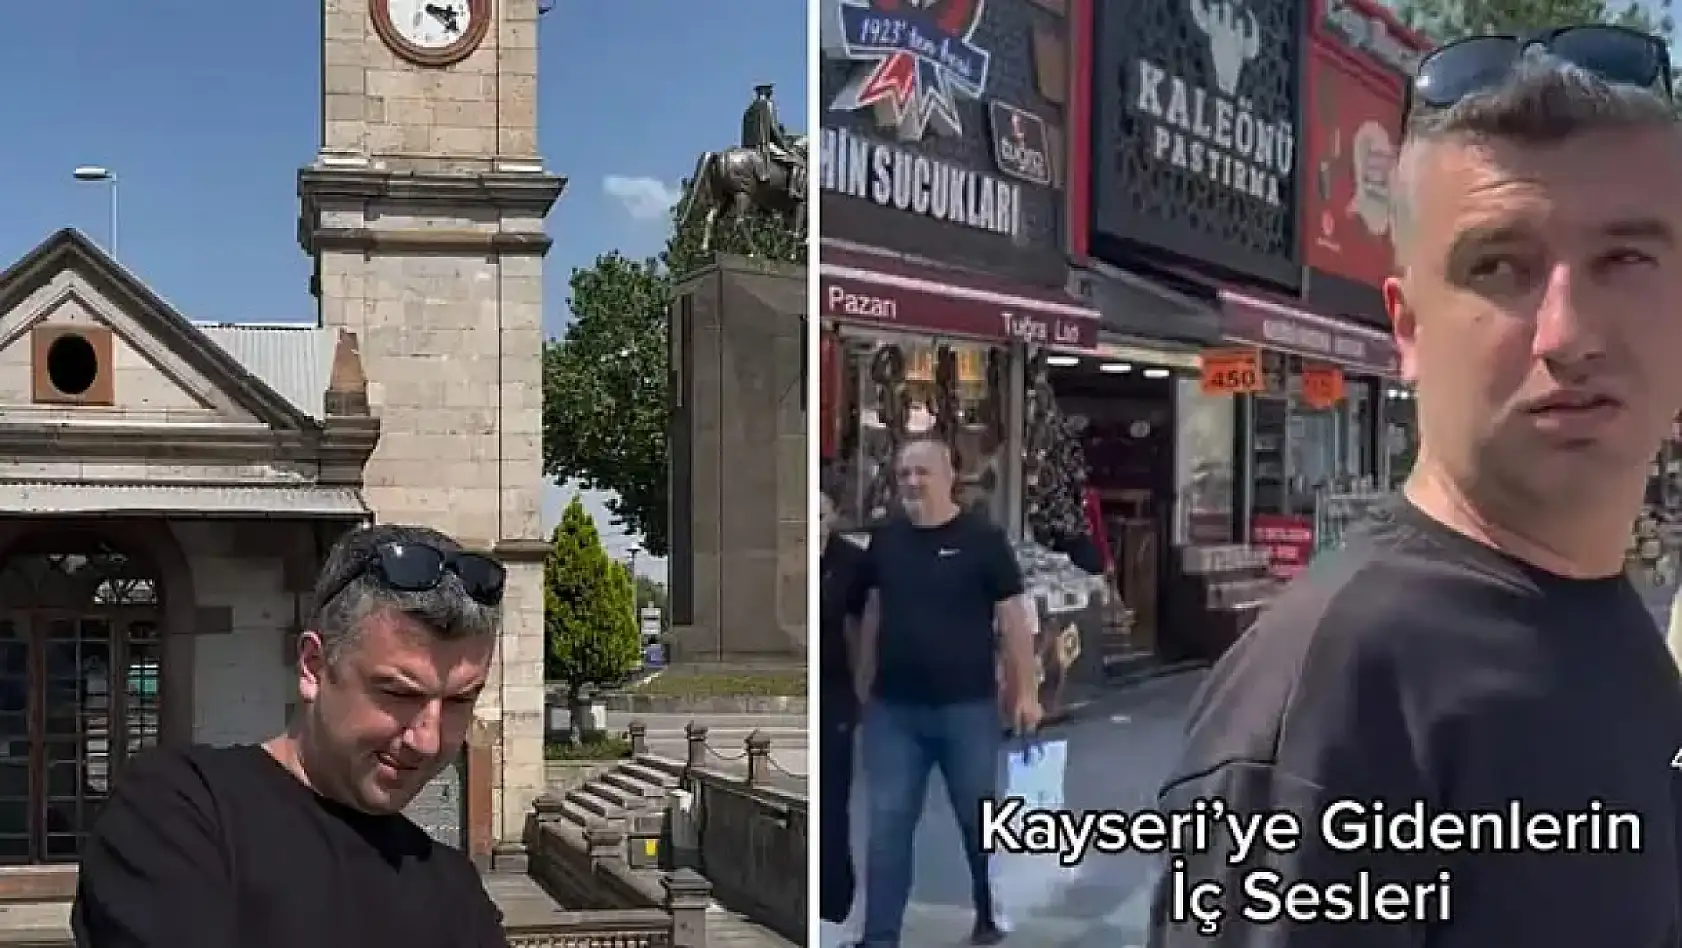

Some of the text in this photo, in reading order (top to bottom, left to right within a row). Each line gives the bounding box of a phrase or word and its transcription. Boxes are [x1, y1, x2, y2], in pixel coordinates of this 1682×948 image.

[1139, 58, 1293, 175] KALEÖNÜ
[873, 144, 1020, 237] SUCUKLARI
[1154, 125, 1279, 206] PASTIRMA
[1211, 369, 1257, 390] 450
